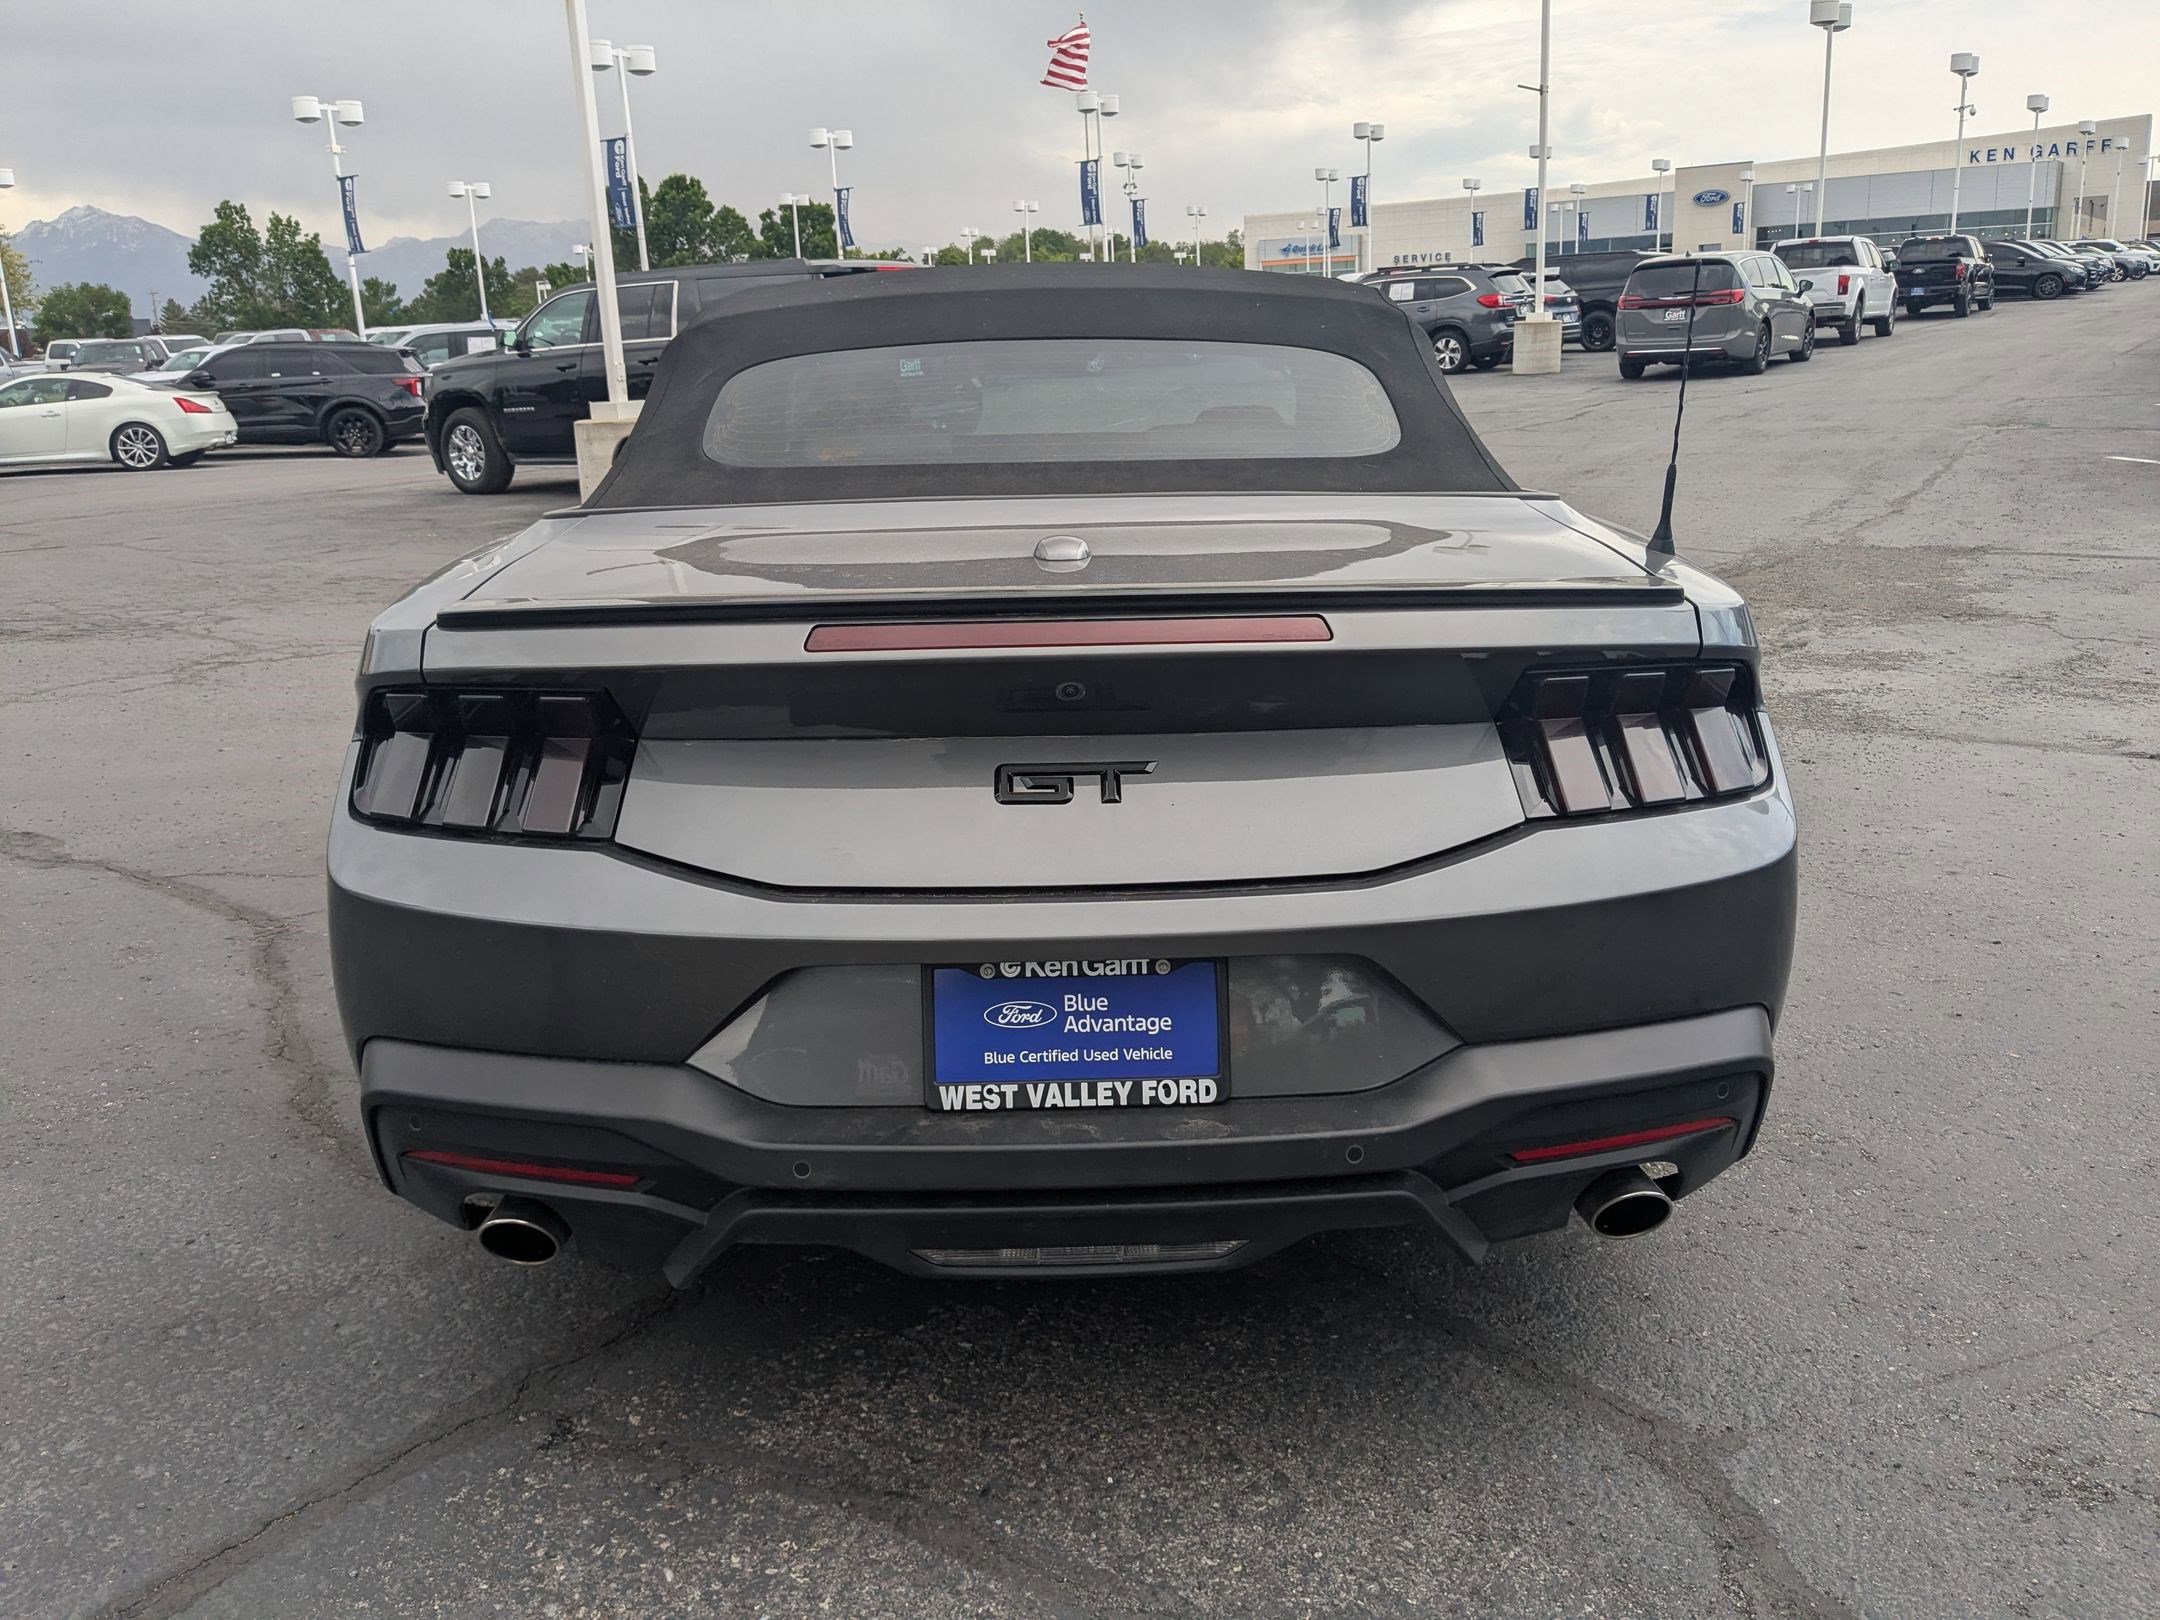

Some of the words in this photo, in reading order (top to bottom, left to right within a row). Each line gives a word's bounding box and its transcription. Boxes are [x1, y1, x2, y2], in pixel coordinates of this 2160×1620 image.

[1970, 147, 2015, 163] KEN
[2031, 138, 2112, 158] GARFF
[613, 156, 621, 178] Ford
[1700, 193, 1721, 203] Ford
[1394, 252, 1452, 264] SERVICE
[1665, 310, 1686, 319] Garff
[994, 760, 1159, 806] GT
[1064, 994, 1108, 1012] Blue
[998, 1004, 1042, 1024] Ford
[1063, 1015, 1172, 1034] Advantage
[984, 1052, 1015, 1064] Blue
[1019, 1049, 1079, 1063] Certified
[1083, 1049, 1119, 1062] Used
[1122, 1047, 1173, 1061] Vehicle
[939, 1085, 1018, 1111] WEST
[1026, 1081, 1135, 1108] VALLEY
[1142, 1079, 1218, 1105] FORD
